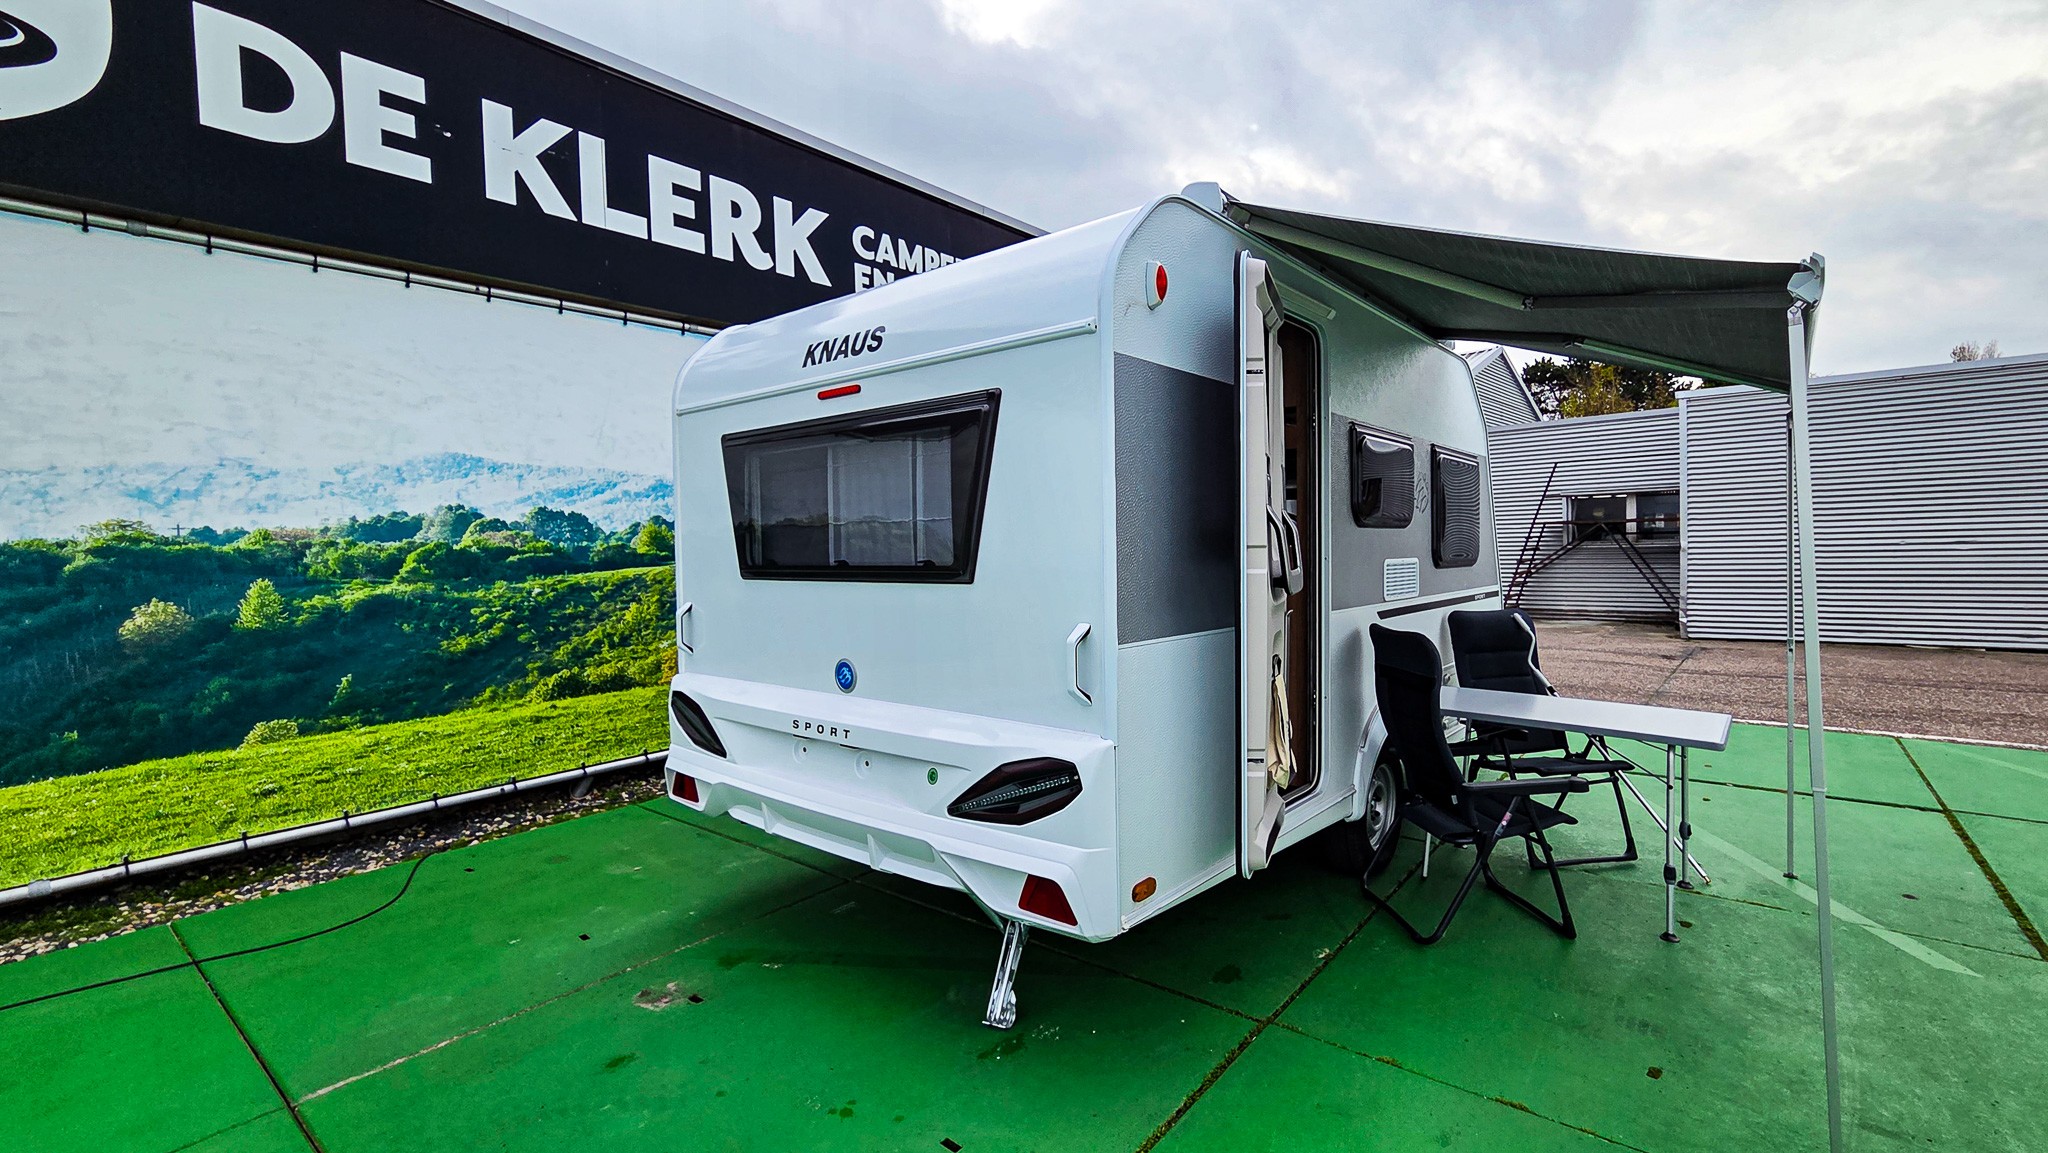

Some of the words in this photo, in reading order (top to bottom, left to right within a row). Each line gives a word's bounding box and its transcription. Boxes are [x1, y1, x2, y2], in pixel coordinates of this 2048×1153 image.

[192, 1, 432, 184] DE
[482, 98, 832, 287] KLERK
[854, 262, 895, 293] EN
[802, 325, 886, 369] KNAUS
[792, 719, 851, 739] SPORT
